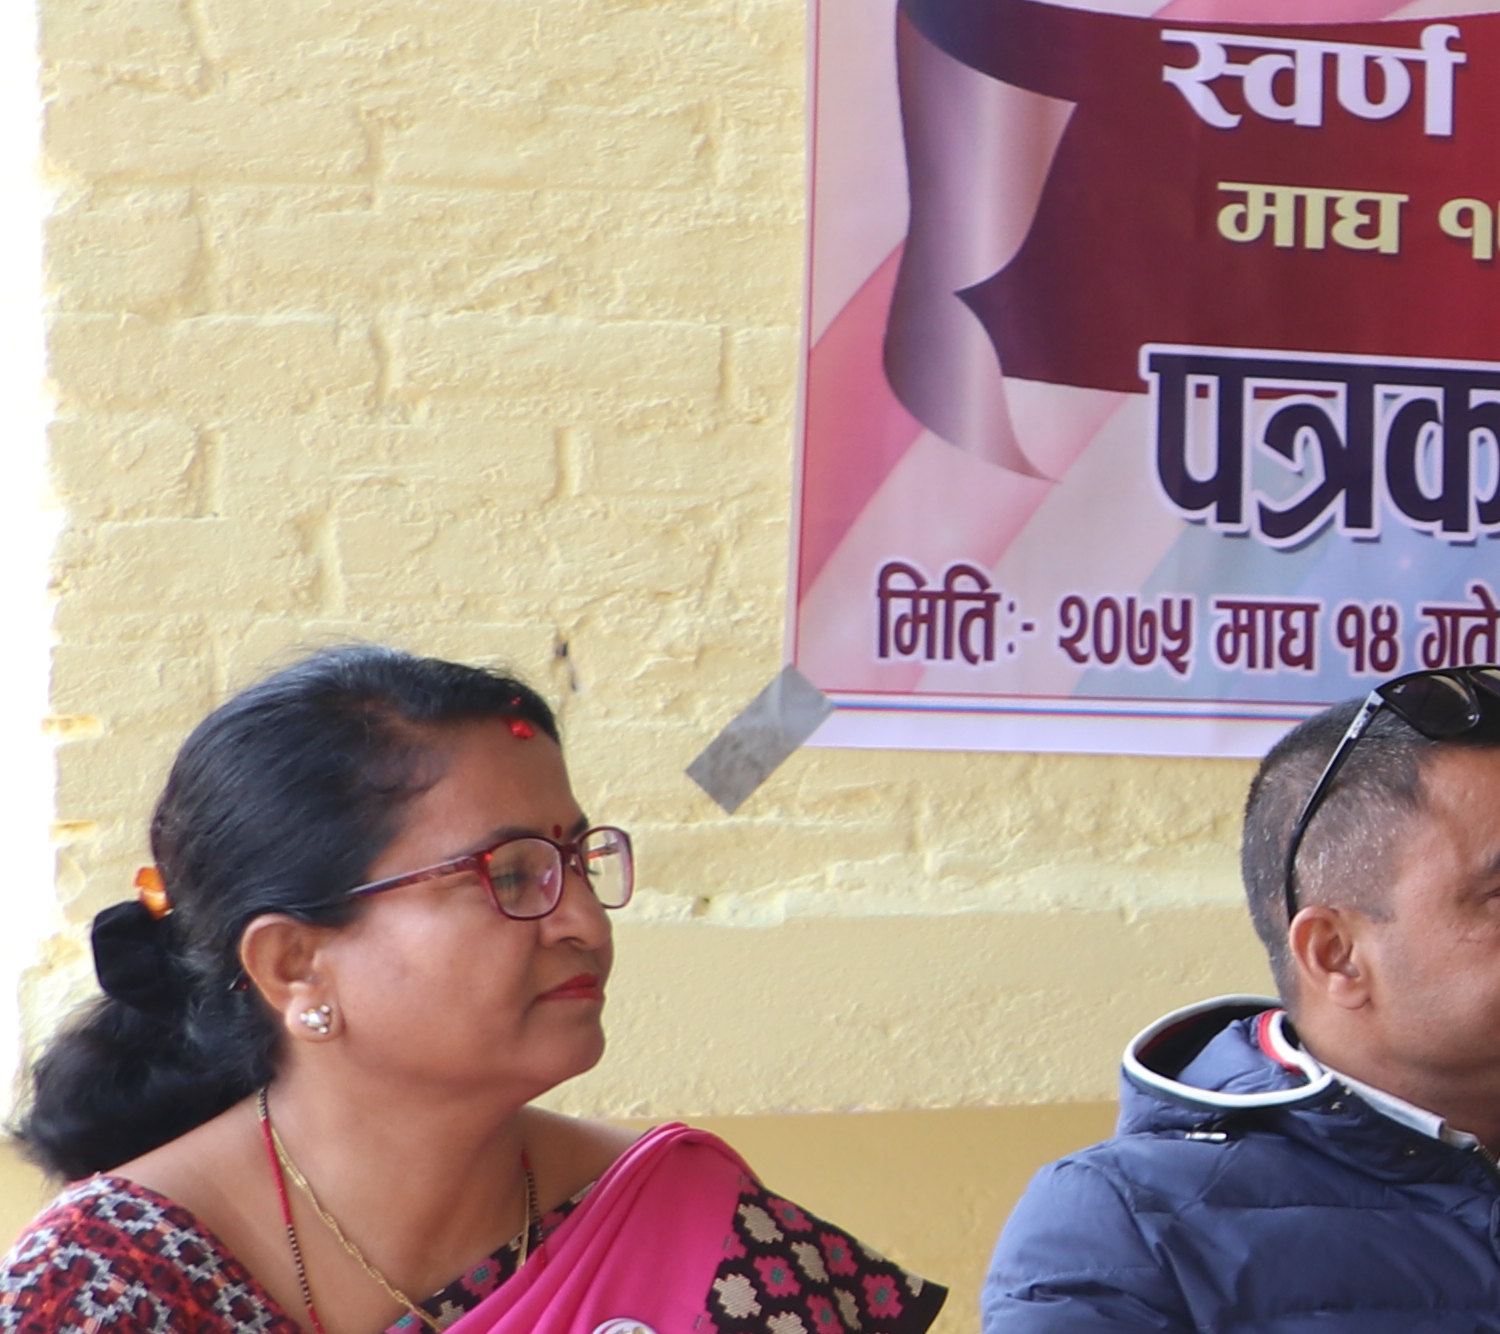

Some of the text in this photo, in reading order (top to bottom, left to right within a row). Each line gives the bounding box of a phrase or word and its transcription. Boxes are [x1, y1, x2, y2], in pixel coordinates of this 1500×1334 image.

[1161, 25, 1467, 136] स्वर्ण
[1217, 180, 1408, 255] माघ
[1059, 595, 1194, 674] २०७५
[1214, 599, 1320, 671] माघ
[1336, 604, 1400, 673] १४
